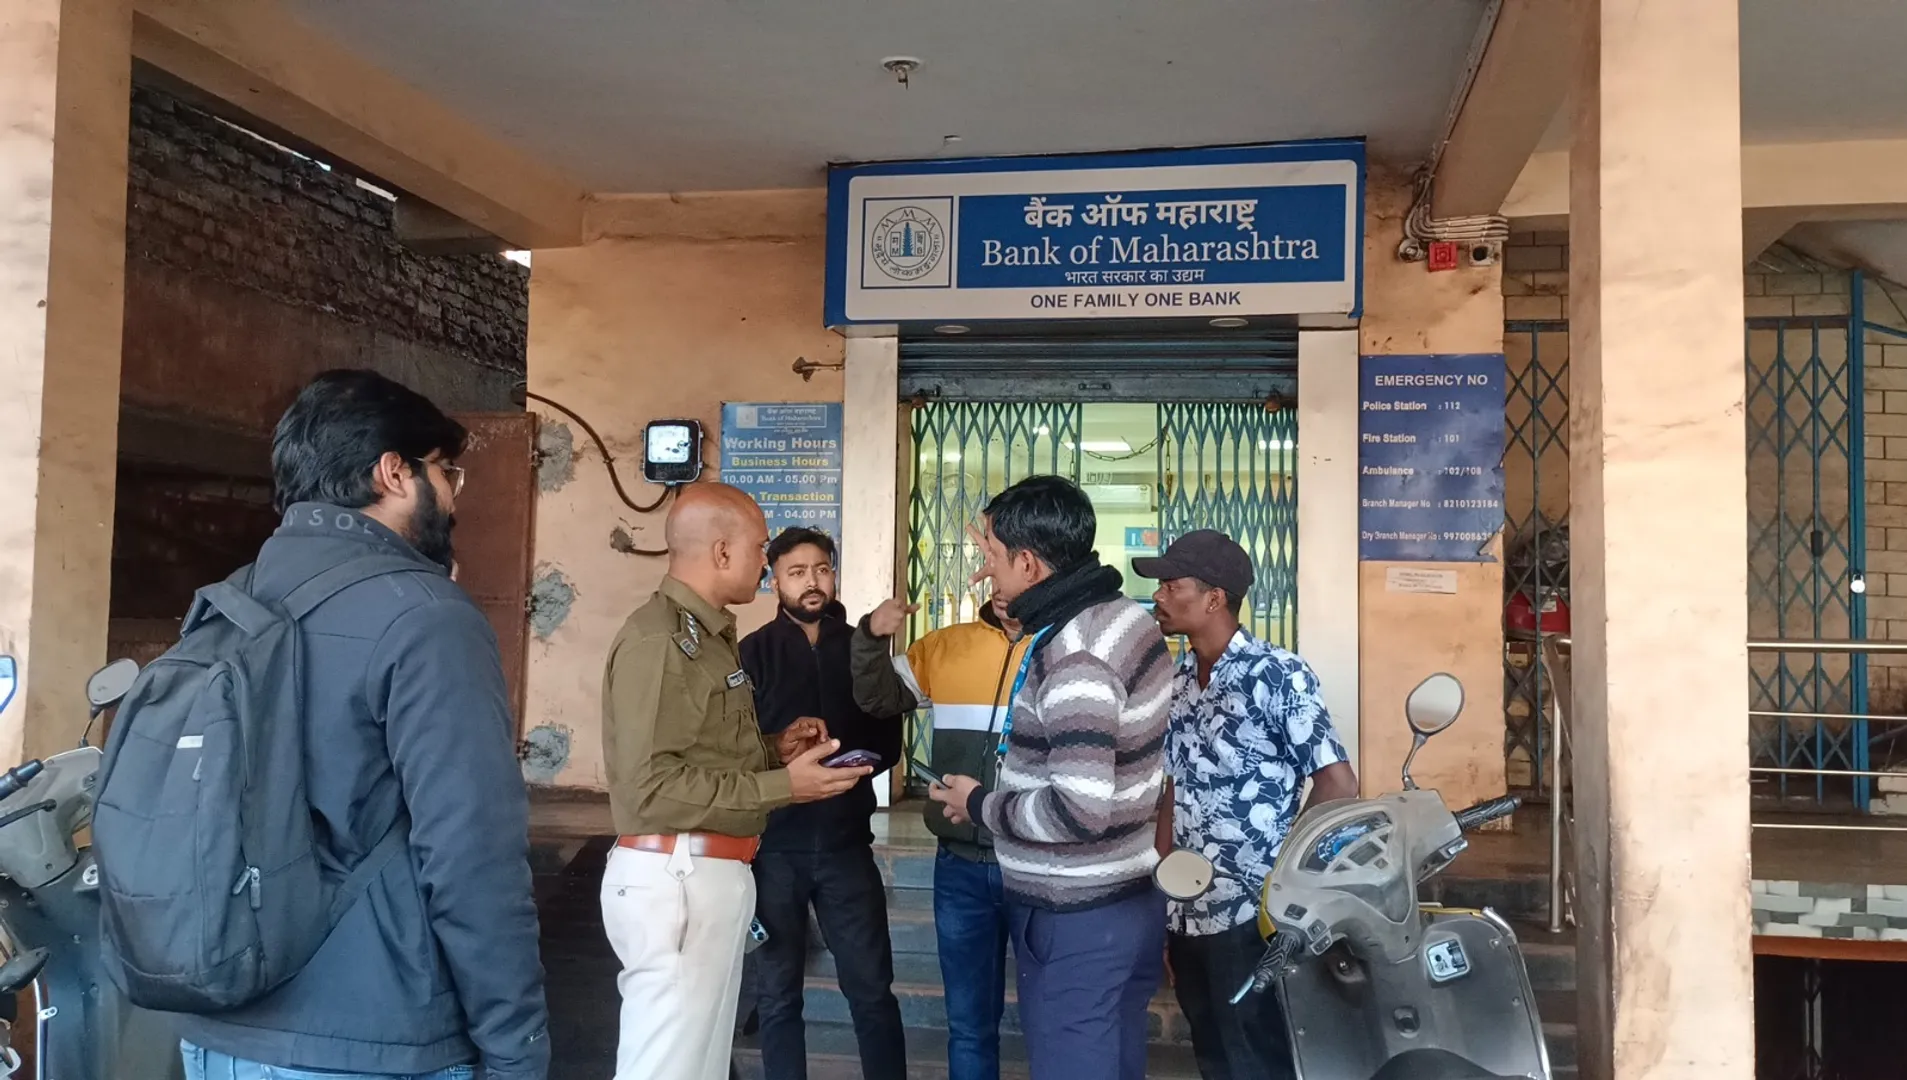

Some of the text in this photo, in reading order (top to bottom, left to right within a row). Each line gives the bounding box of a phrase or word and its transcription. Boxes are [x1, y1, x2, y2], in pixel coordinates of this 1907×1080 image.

[1023, 194, 1258, 230] बैंक ऑफ महाराष्ट्र
[982, 231, 1320, 266] Bank of Maharashtra
[1064, 269, 1205, 284] भारत सरकार का उद्यम
[1031, 291, 1241, 308] ONE FAMILY ONE BANK
[1375, 374, 1488, 387] EMERGENCY NO
[1363, 401, 1391, 410] Police
[1393, 401, 1427, 410] Station
[1362, 433, 1381, 443] Fire
[1383, 433, 1416, 443] Station
[724, 437, 837, 451] Working Hours
[731, 456, 829, 466] Business Hours
[1362, 466, 1414, 475] Ambulance
[723, 475, 753, 484] 10.00
[757, 475, 774, 484] AM
[785, 475, 816, 484] 05.00
[759, 491, 834, 501] Transaction
[1362, 499, 1387, 508] Branch
[1389, 499, 1419, 510] Manager
[784, 510, 816, 519] 04.00
[819, 510, 837, 519] PM
